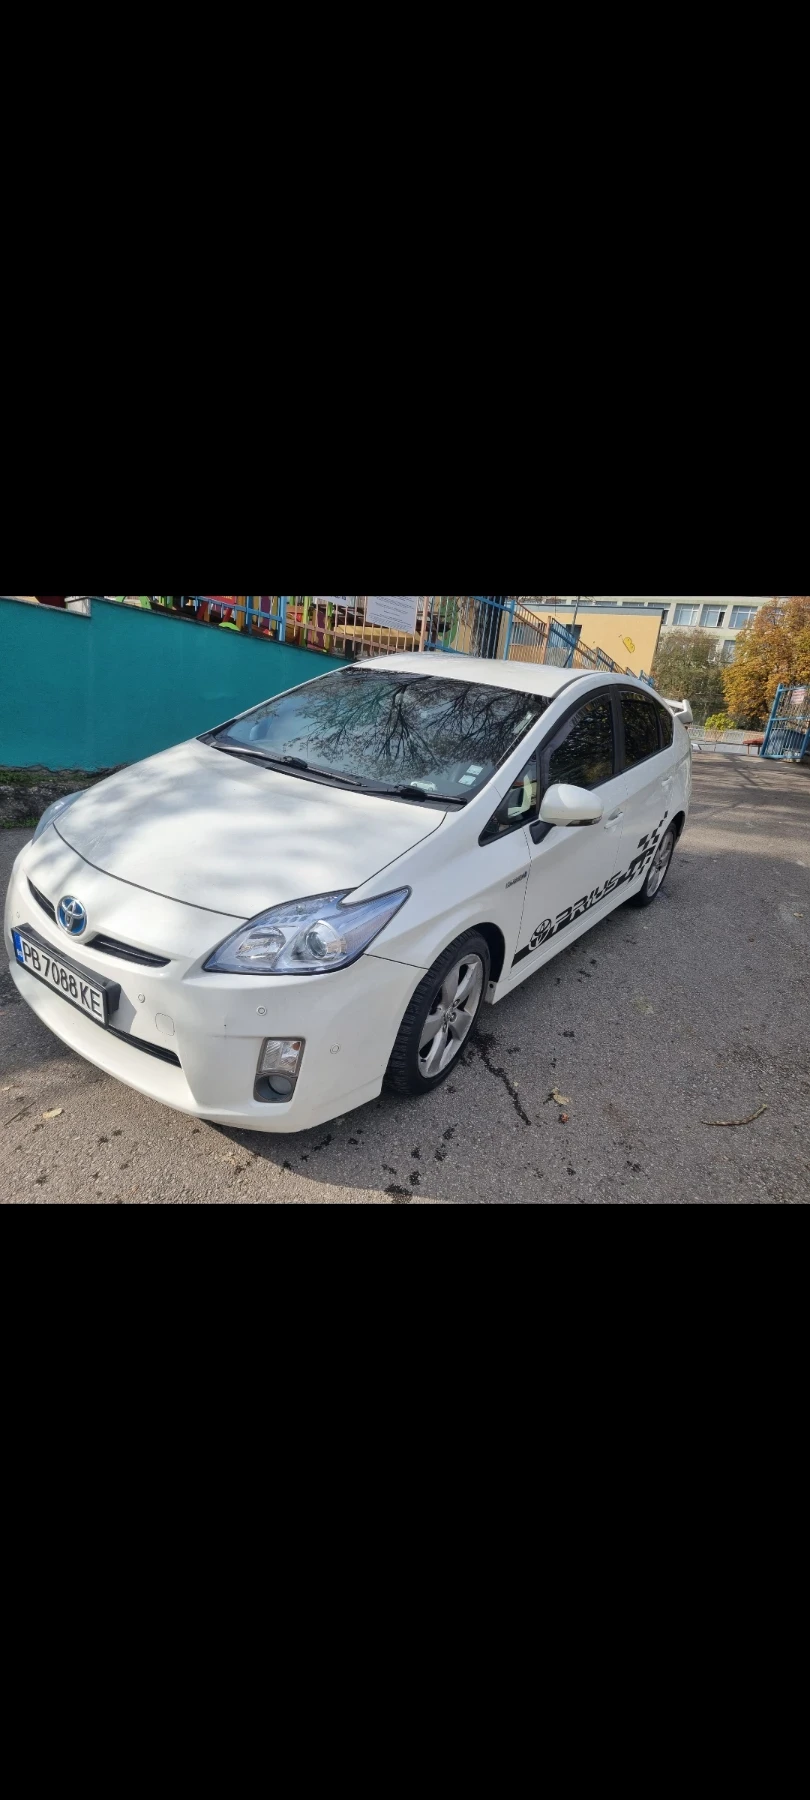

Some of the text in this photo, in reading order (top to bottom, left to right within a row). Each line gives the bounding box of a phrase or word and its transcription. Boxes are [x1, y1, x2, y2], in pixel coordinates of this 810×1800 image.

[552, 870, 622, 933] PRIUS
[22, 941, 103, 1018] PB 7088 KE
